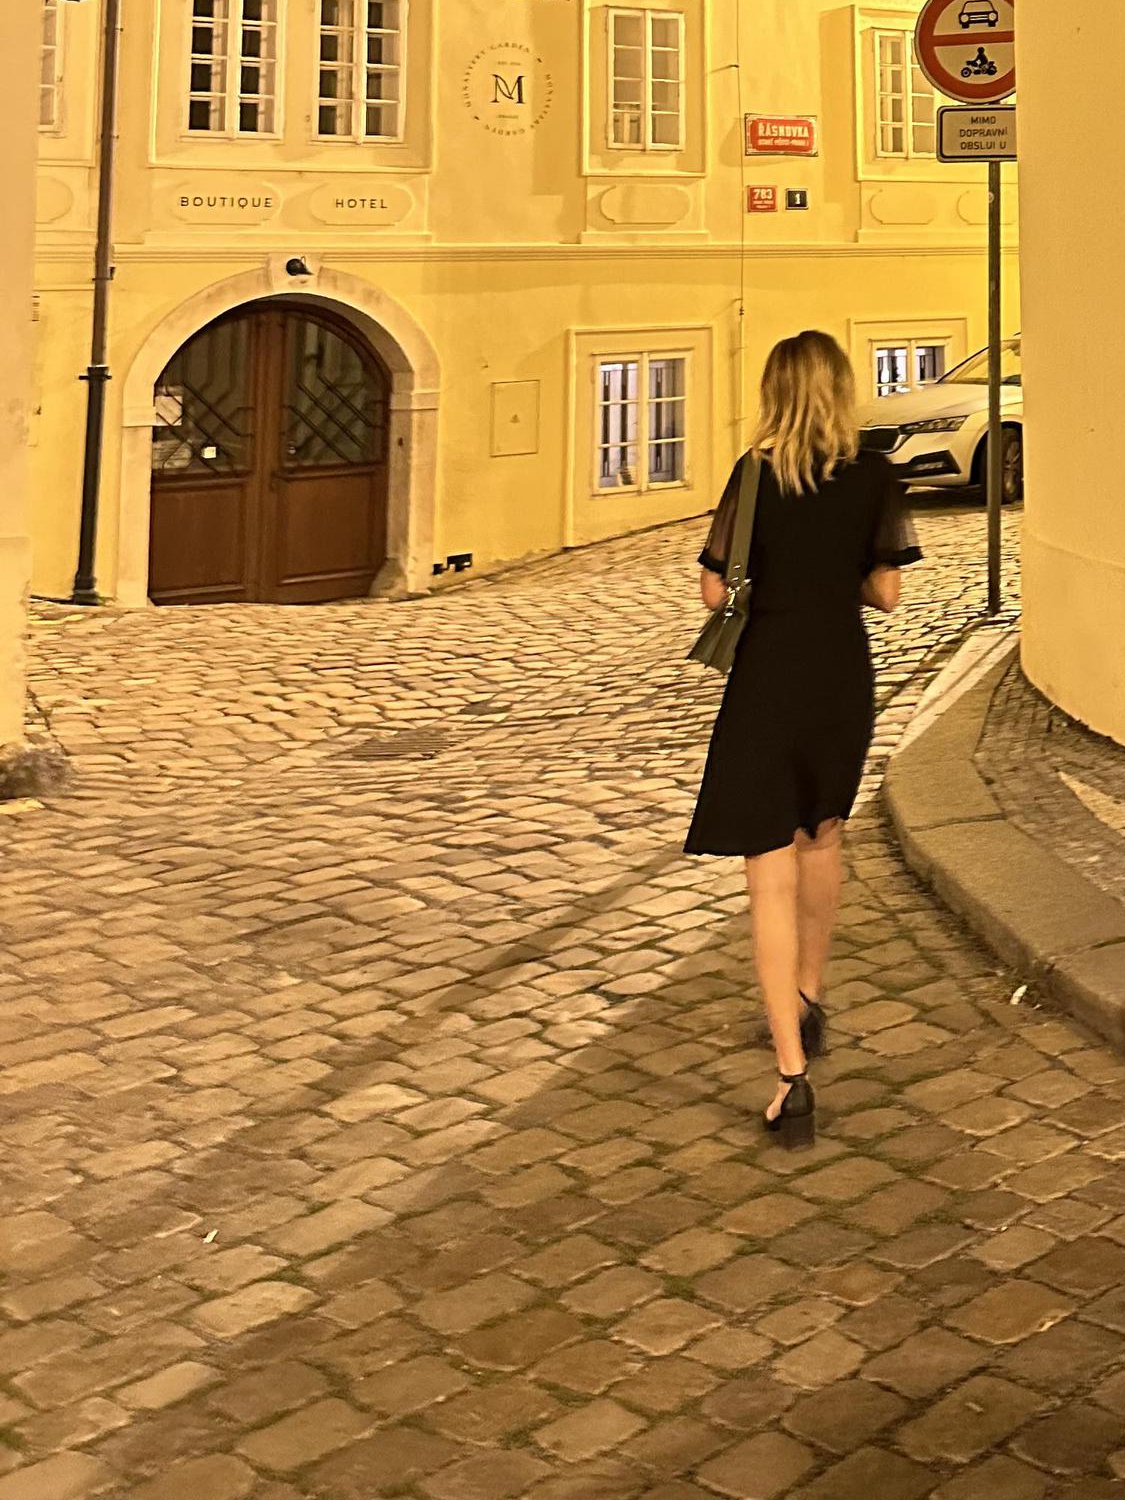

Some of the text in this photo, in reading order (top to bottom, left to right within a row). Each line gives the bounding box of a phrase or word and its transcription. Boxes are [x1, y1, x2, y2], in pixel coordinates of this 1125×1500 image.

[970, 116, 997, 125] MIMO
[959, 126, 1008, 138] DOPRAVNÍ
[753, 188, 773, 200] 783
[794, 193, 801, 205] 1
[180, 196, 388, 209] BOUTIQUE HOTEL
